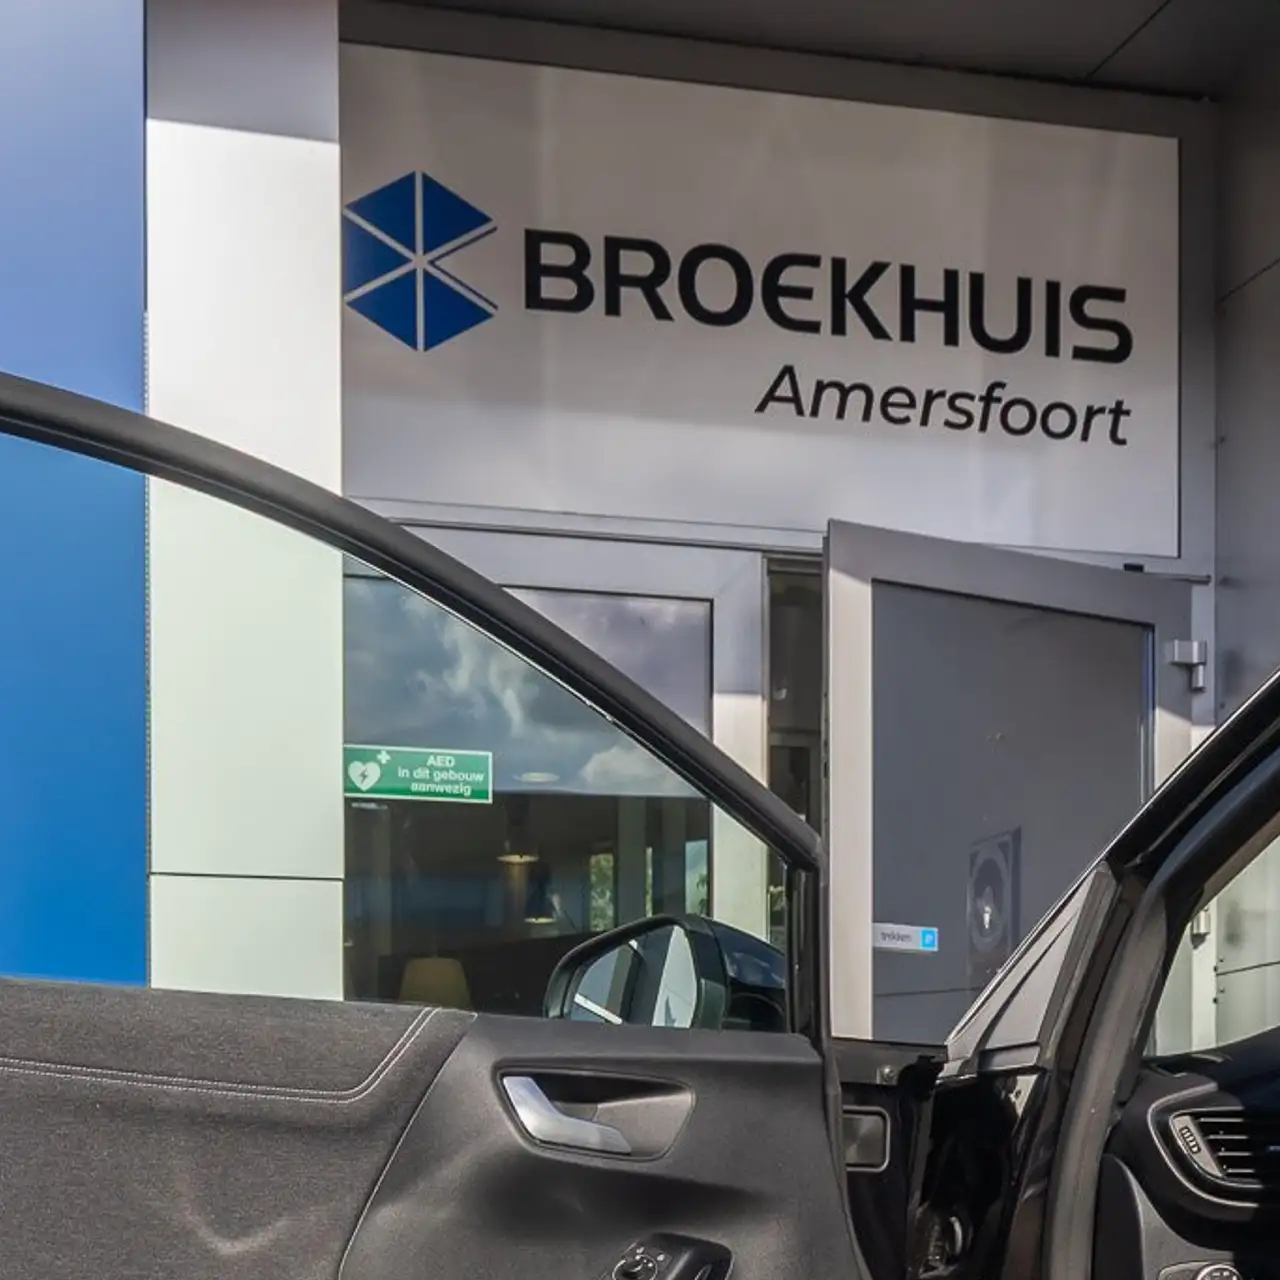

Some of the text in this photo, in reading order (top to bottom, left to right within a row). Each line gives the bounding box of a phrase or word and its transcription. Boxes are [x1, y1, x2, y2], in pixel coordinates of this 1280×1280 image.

[523, 227, 1134, 364] BROEKHUIS
[754, 364, 1132, 446] Amersfoort
[426, 755, 455, 767] AED
[413, 766, 429, 779] dit
[433, 769, 484, 782] gebouw
[411, 782, 472, 796] aanwezig
